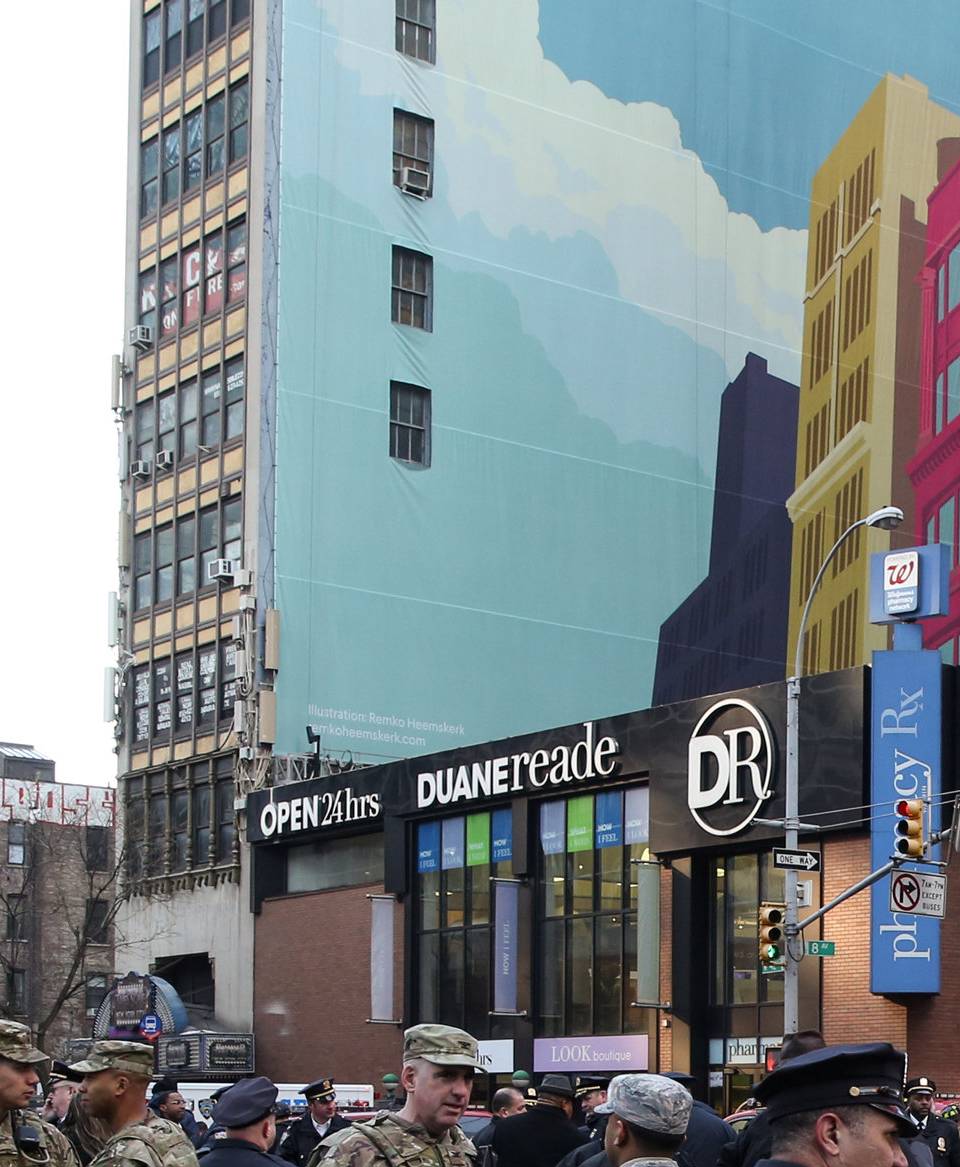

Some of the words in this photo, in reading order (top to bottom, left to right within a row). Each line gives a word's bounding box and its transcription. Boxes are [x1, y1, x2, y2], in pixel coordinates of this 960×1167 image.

[308, 703, 366, 722] Illustration:
[369, 712, 406, 728] Remko
[407, 718, 465, 736] Heemskerk
[260, 794, 320, 837] OPEN
[779, 856, 794, 864] ONE
[799, 857, 813, 866] WAY
[921, 891, 943, 900] EXCEPT
[922, 903, 941, 912] BUSES
[811, 943, 819, 954] 8
[551, 1045, 591, 1063] LOOK
[593, 1049, 632, 1062] boutique
